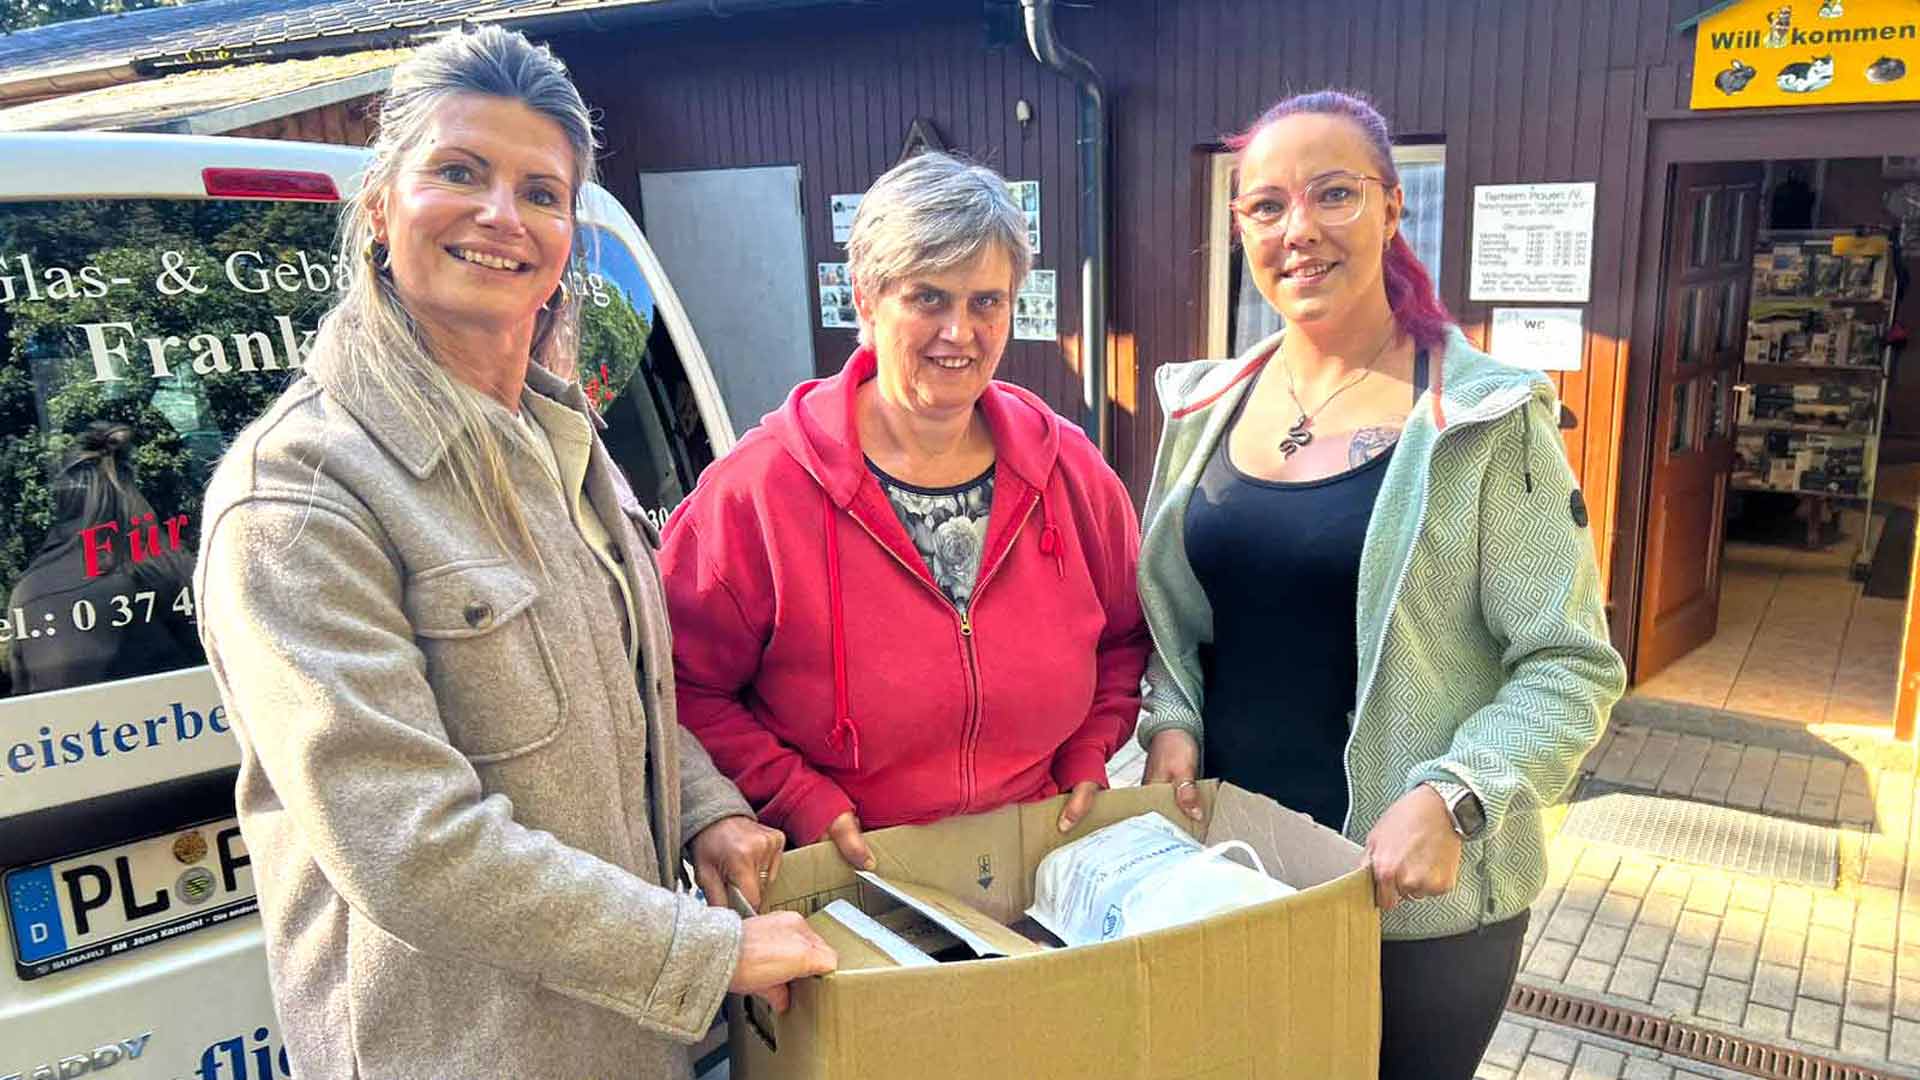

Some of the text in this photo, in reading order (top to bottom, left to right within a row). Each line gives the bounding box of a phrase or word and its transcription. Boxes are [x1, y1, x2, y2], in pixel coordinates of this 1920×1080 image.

[155, 250, 208, 295] &
[77, 315, 318, 384] Frank
[1523, 319, 1545, 330] WC
[78, 512, 189, 581] Für
[0, 607, 55, 642] el.:
[72, 599, 97, 631] 0
[110, 591, 156, 627] 37
[0, 702, 231, 776] eisterbe
[62, 855, 170, 936] PL
[30, 922, 49, 944] D
